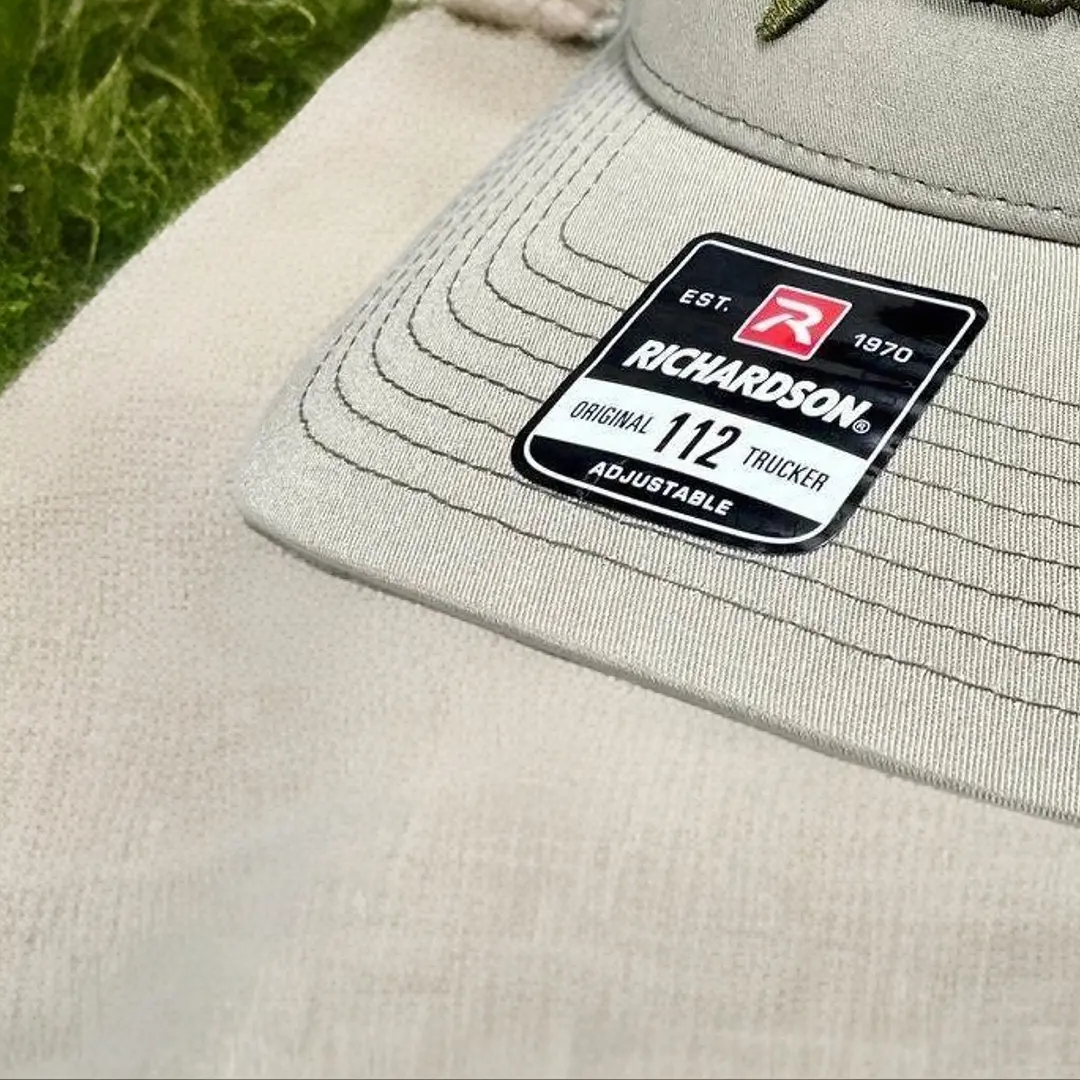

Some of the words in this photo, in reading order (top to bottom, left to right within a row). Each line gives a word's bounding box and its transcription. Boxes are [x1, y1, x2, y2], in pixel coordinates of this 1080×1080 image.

[680, 288, 732, 312] EST.
[854, 332, 914, 364] 1970
[570, 400, 656, 435] ORIGINAL
[654, 411, 742, 470] 112
[742, 445, 829, 493] TRUCKER
[588, 461, 734, 516] ADJUSTABLE
